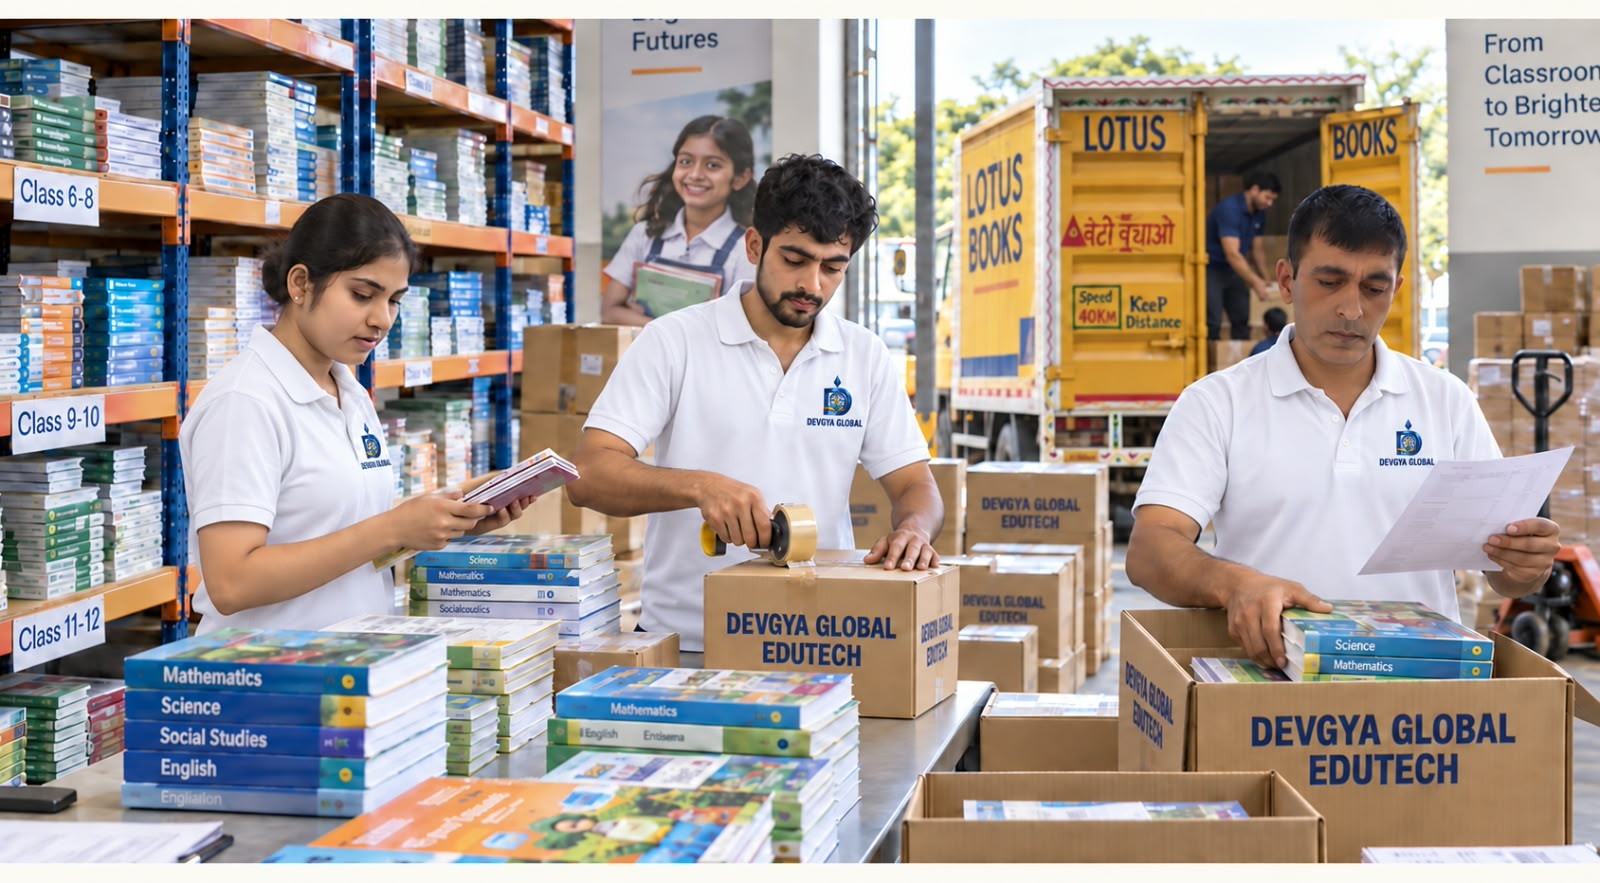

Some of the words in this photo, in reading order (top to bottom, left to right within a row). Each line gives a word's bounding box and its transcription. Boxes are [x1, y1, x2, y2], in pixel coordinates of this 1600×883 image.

[632, 31, 719, 52] Futures
[1484, 33, 1544, 54] From
[1484, 97, 1508, 116] to
[1083, 114, 1166, 151] LOTUS
[1333, 118, 1397, 160] BOOKS
[20, 178, 64, 206] Class
[68, 185, 94, 209] 6-8
[967, 152, 1023, 219] LOTUS
[969, 212, 1023, 273] BOOKS
[1078, 290, 1113, 306] Speed
[1126, 314, 1182, 329] Distance
[18, 410, 62, 436] Class
[67, 405, 100, 430] 9-10
[806, 418, 835, 427] DEVGYA
[836, 419, 863, 428] GLOBAL
[1379, 458, 1407, 466] DEVGYA
[1408, 457, 1435, 466] GLOBAL
[982, 497, 1031, 511] DEVGYA
[1034, 497, 1081, 512] GLOBAL
[1001, 514, 1060, 529] EDUTECH
[469, 555, 498, 566] Science
[438, 571, 485, 581] Mathematics
[440, 588, 492, 598] Mathematics
[963, 594, 1001, 608] DEVGYA
[1004, 595, 1046, 609] GLOBAL
[726, 612, 809, 637] DEVGYA
[815, 615, 897, 640] GLOBAL
[978, 610, 1028, 624] EDUTECH
[19, 624, 61, 652] Class
[64, 606, 101, 640] 11-12
[762, 641, 861, 667] EDUTECH
[1335, 639, 1376, 652] Science
[1333, 659, 1394, 672] Mathematics
[162, 666, 263, 688] Mathematics
[161, 696, 221, 716] Science
[610, 702, 678, 718] Mathematics
[585, 727, 618, 741] English
[1133, 699, 1163, 750] EDUTECH
[1251, 715, 1381, 747] DEVGYA
[1391, 713, 1516, 745] GLOBAL
[160, 727, 206, 747] Social
[210, 728, 268, 748] Studies
[160, 758, 217, 781] English
[1308, 753, 1459, 786] EDUTECH
